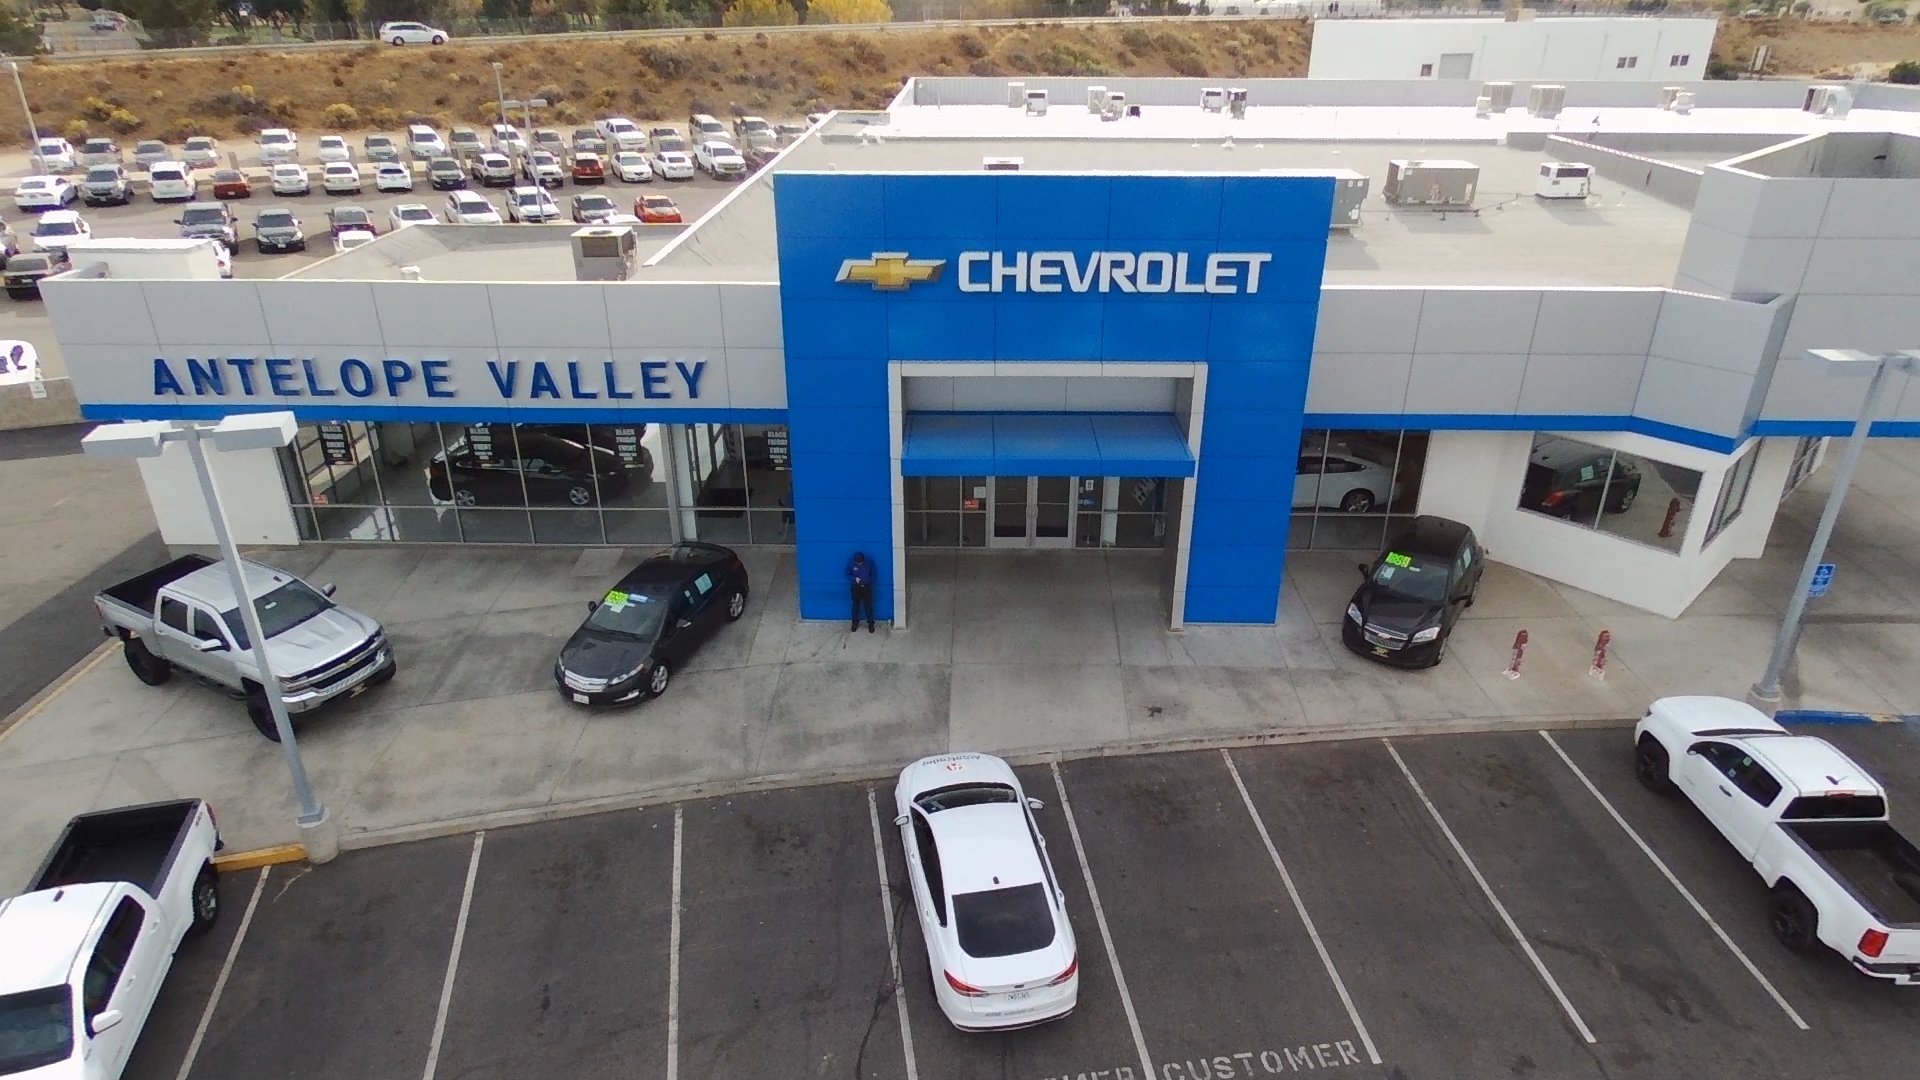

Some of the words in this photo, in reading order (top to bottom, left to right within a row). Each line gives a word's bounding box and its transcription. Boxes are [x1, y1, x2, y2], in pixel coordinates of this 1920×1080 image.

[958, 251, 1273, 295] CHEVROLET
[153, 357, 455, 399] ANTELOPE
[486, 359, 708, 400] VALLEY
[1162, 1039, 1362, 1080] CUSTOMER
